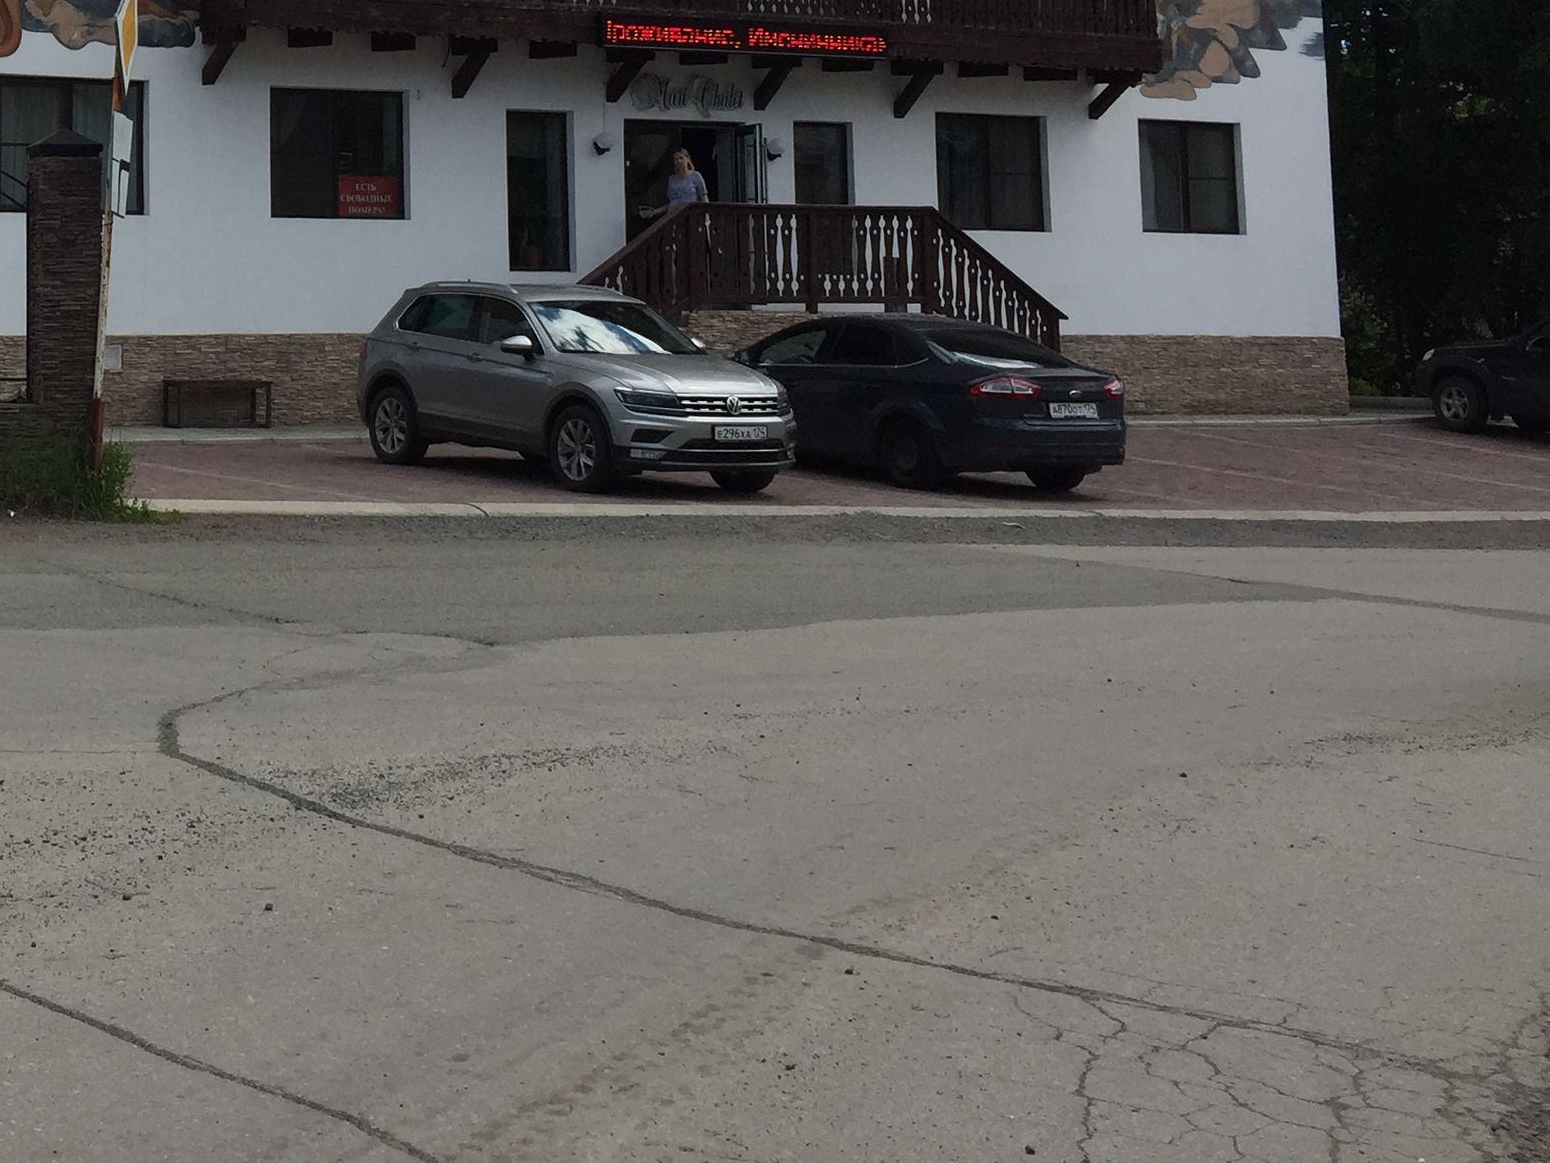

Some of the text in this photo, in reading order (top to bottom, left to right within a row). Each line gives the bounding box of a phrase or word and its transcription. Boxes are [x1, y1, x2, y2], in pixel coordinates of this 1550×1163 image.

[606, 20, 742, 49] роживание,
[355, 183, 377, 191] ЕСТЬ
[340, 194, 392, 203] СВОБОДНЫЕ
